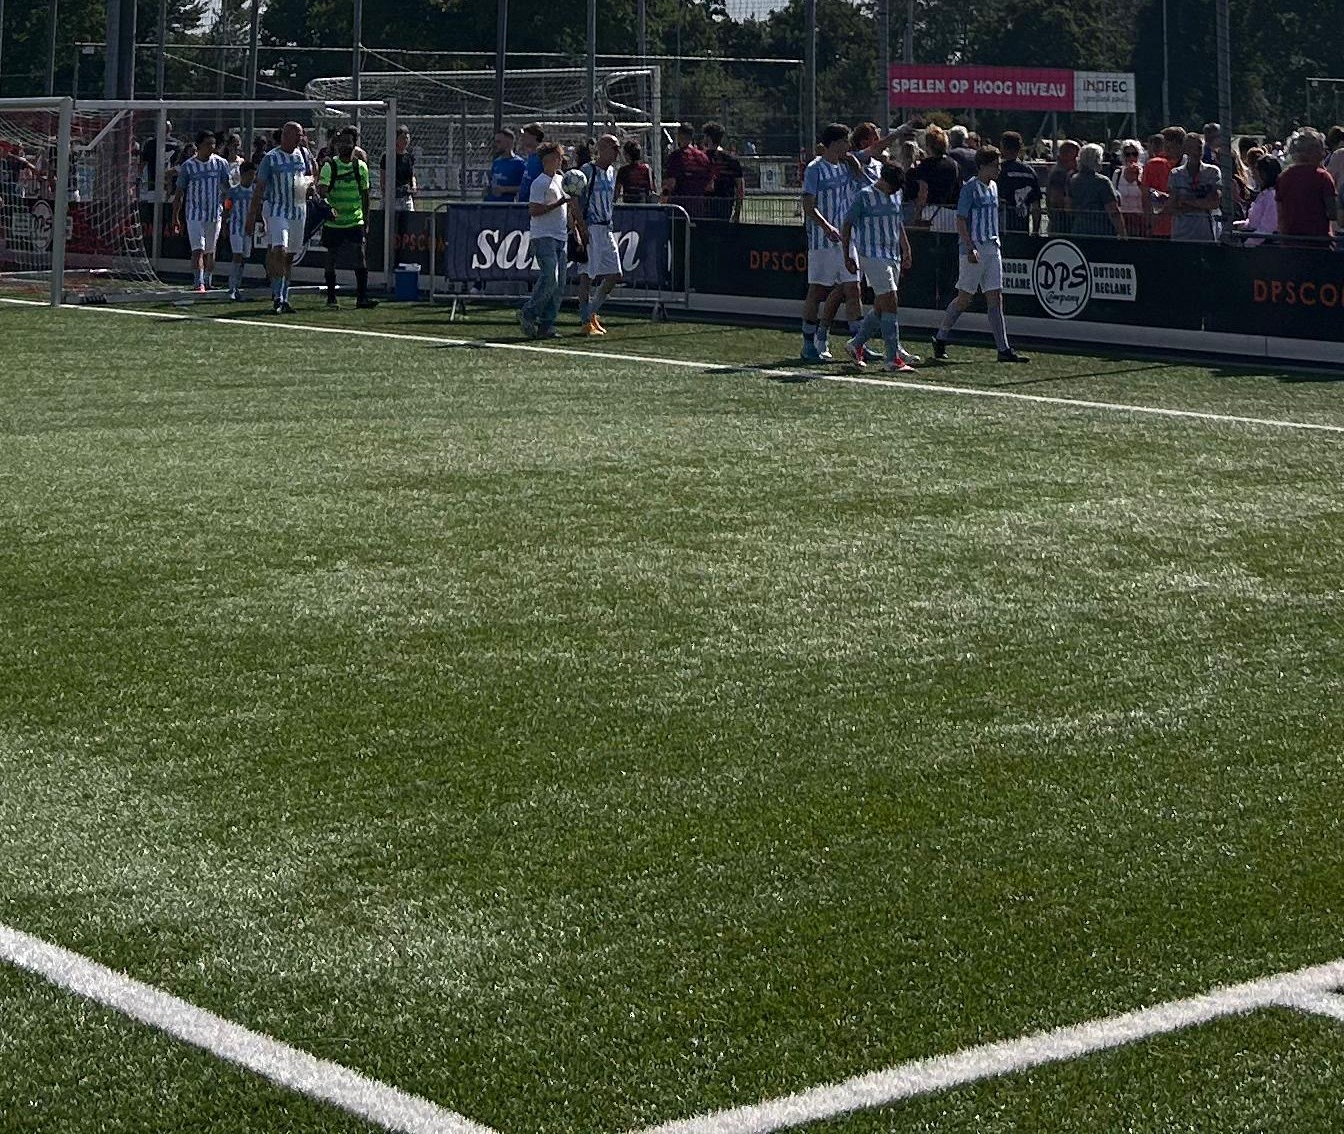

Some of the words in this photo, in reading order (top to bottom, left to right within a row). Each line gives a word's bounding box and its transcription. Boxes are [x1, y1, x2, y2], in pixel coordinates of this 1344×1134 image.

[892, 78, 946, 95] SPELEN
[949, 79, 969, 95] OP
[973, 80, 1013, 96] HOOG
[1017, 82, 1066, 98] NIVEAU
[1037, 260, 1087, 291] DPS
[1093, 267, 1132, 279] OUTDOOR
[1095, 283, 1132, 295] RECLAME
